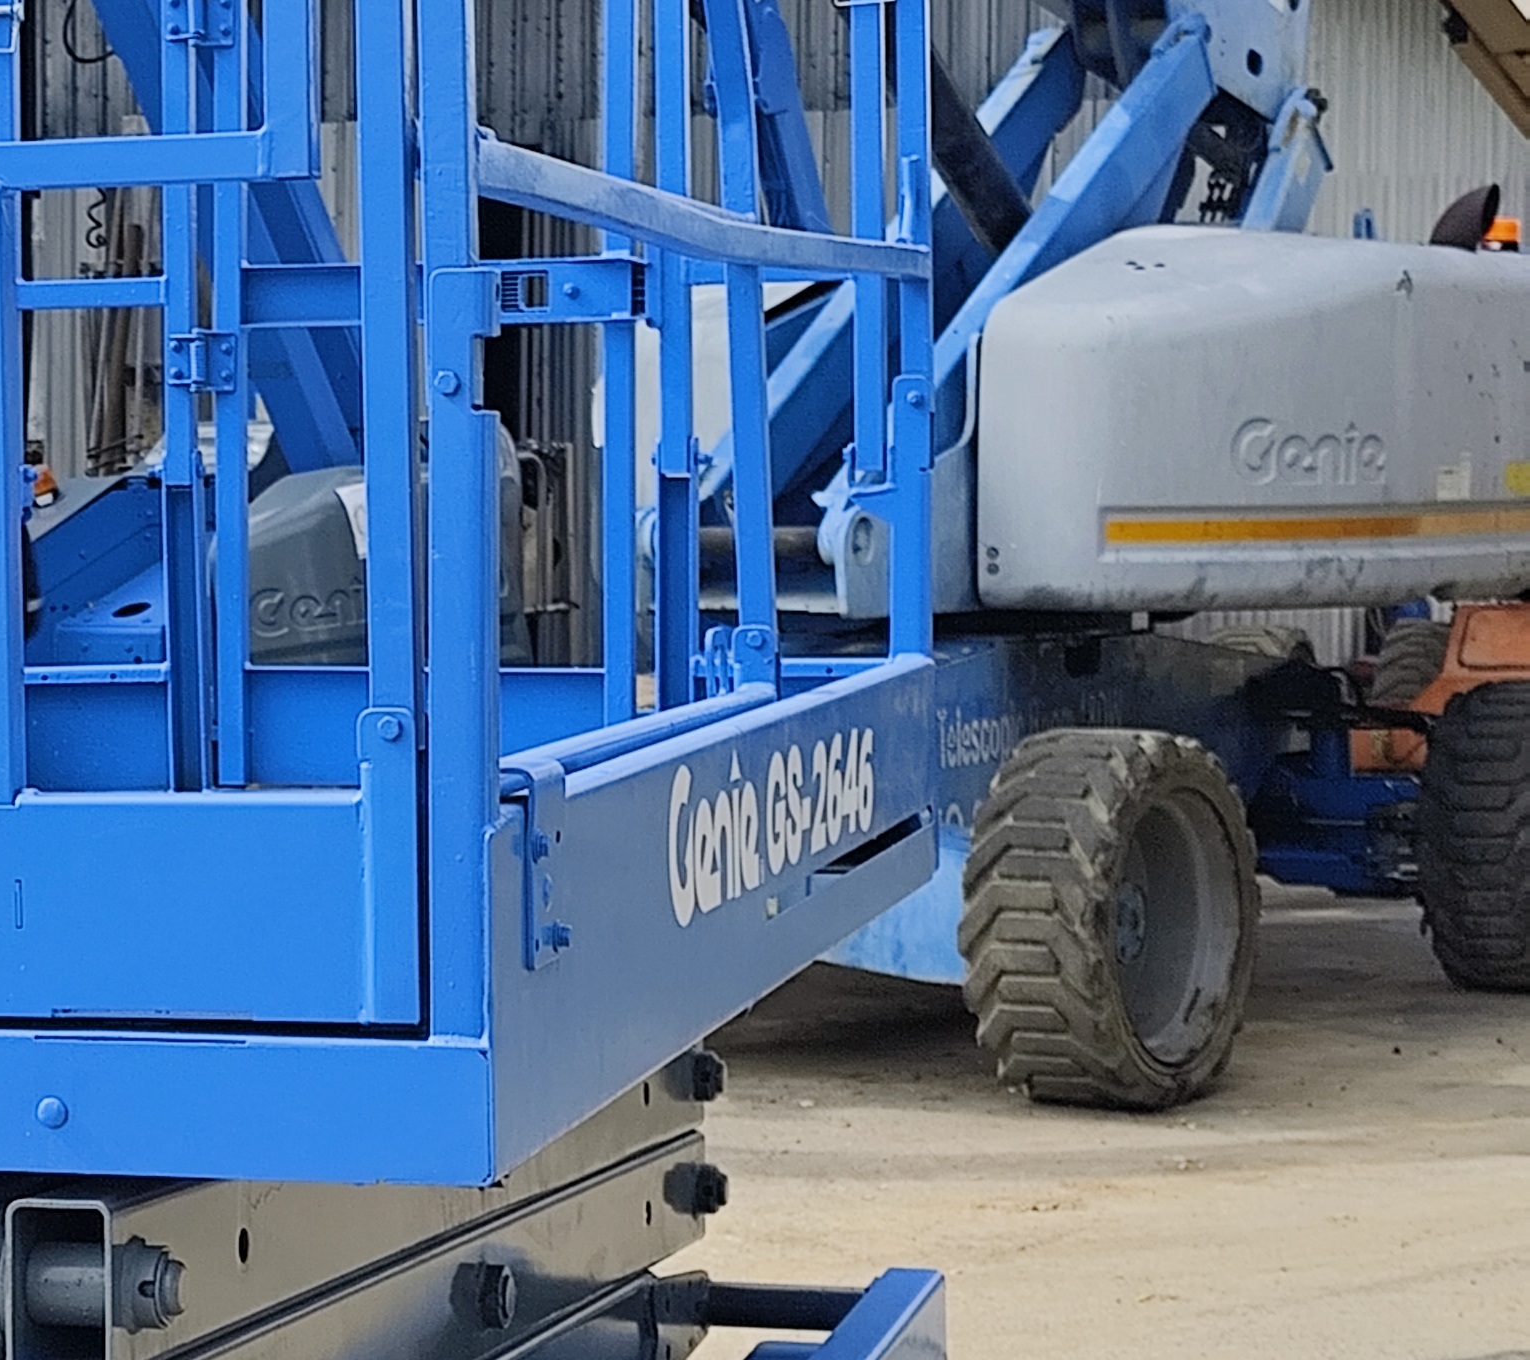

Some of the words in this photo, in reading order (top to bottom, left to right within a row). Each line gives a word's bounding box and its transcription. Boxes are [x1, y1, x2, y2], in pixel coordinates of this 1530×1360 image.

[1231, 417, 1387, 486] Genie
[669, 748, 761, 927] Genie
[766, 727, 875, 876] GS-2646
